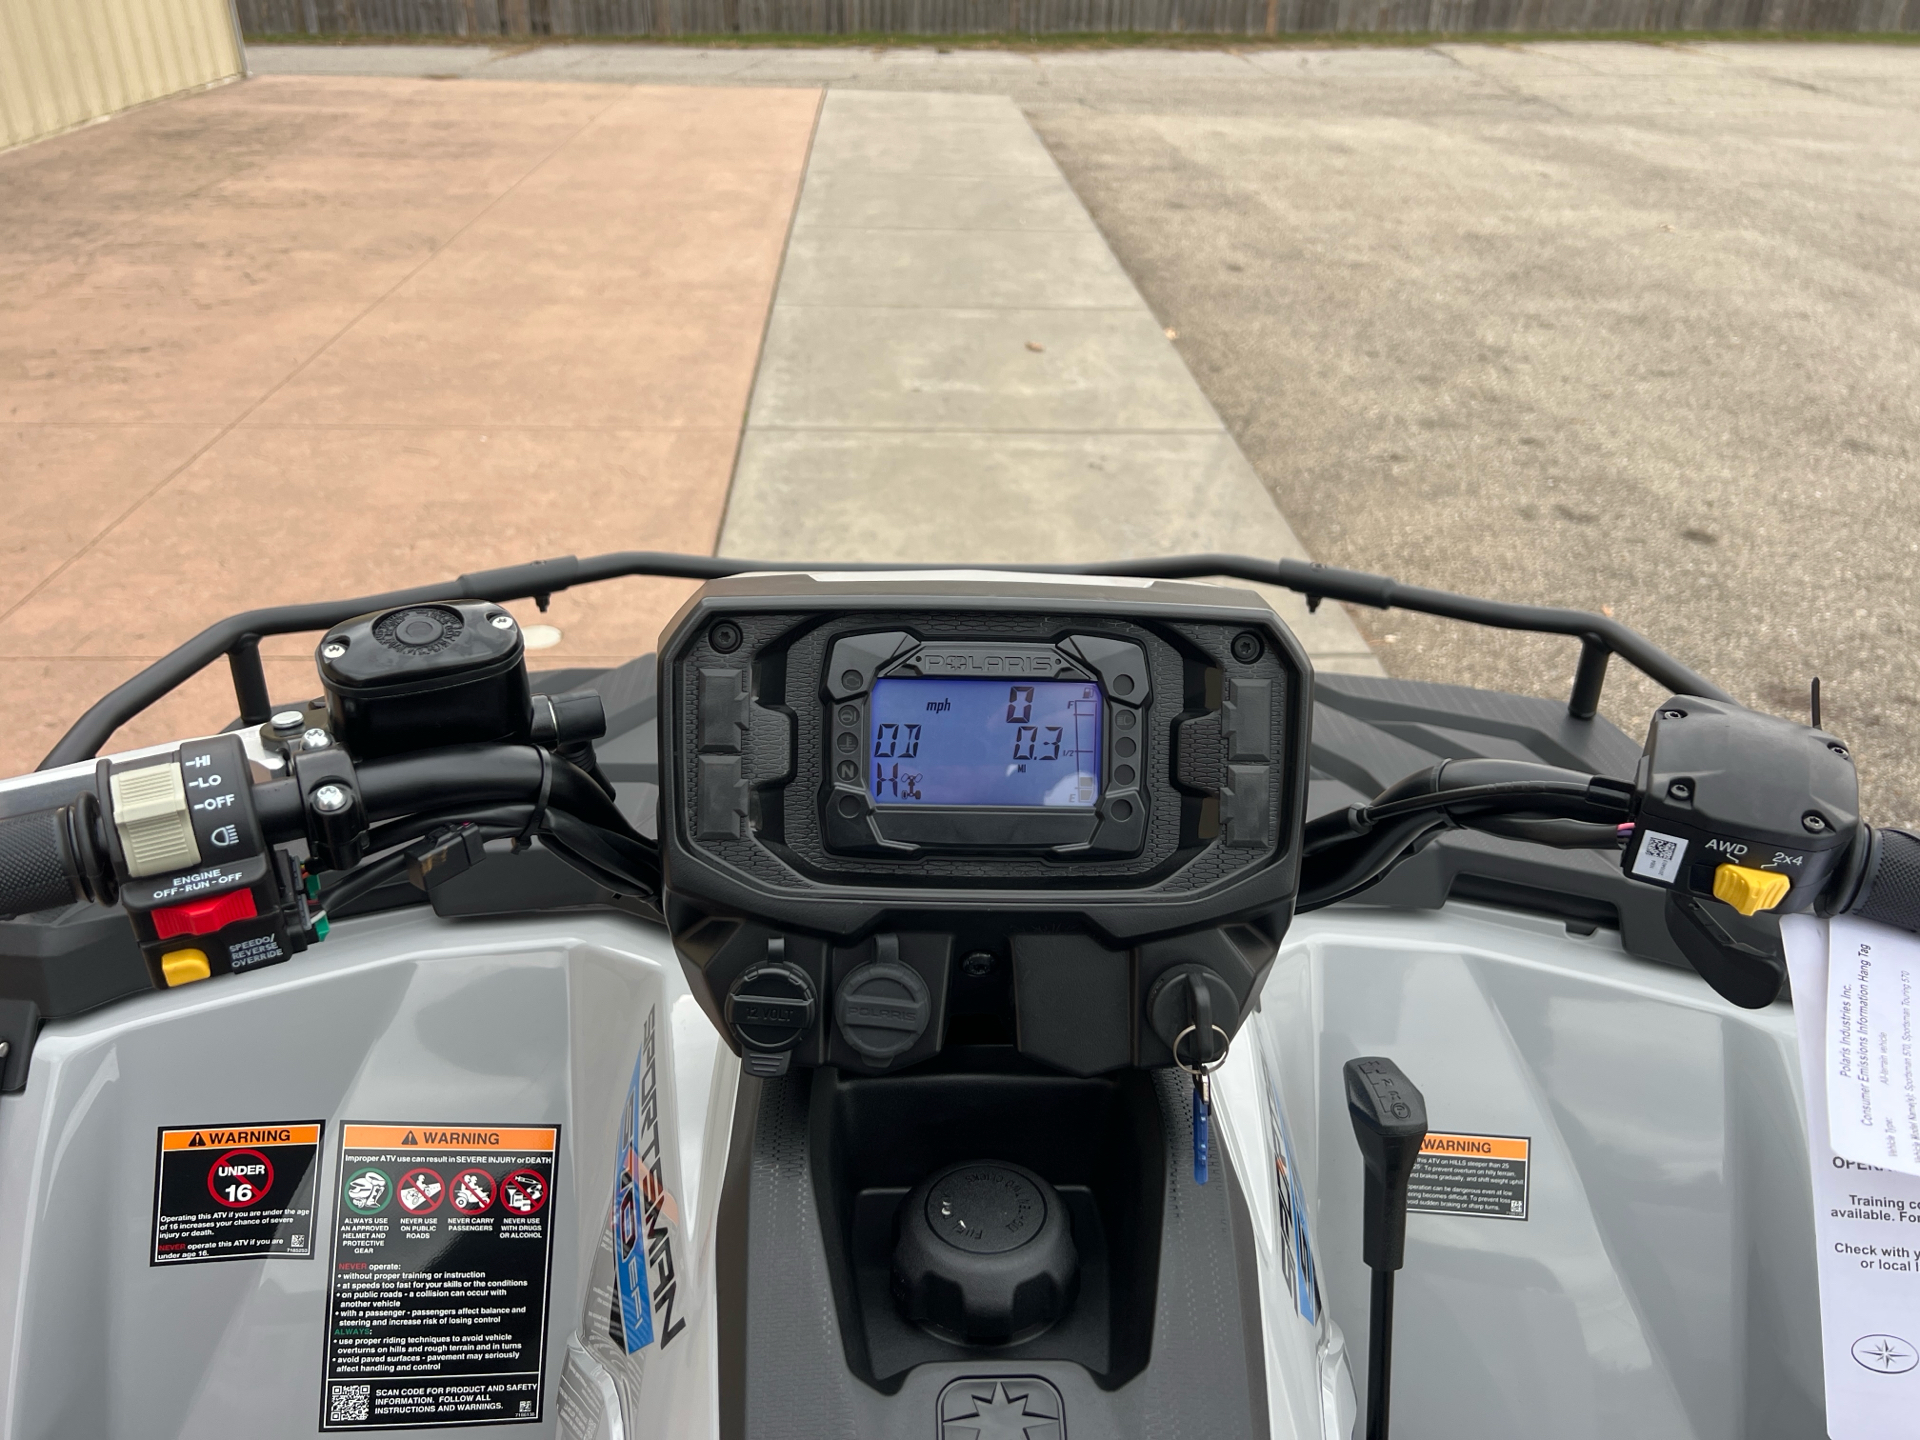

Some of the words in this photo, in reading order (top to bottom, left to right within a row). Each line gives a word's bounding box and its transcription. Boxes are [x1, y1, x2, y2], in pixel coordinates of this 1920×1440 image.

[926, 699, 951, 713] mph
[1013, 726, 1063, 760] 0.3
[1018, 764, 1026, 773] MI
[1705, 839, 1748, 855] AWD
[1772, 852, 1802, 866] 2x4
[173, 869, 221, 886] ENGINE
[229, 933, 275, 951] SPEEDO/
[232, 942, 279, 960] REVERSE
[1858, 944, 1871, 957] Tag
[232, 949, 283, 968] OVERRIDE
[1858, 960, 1871, 982] Hang
[1840, 984, 1852, 999] Inc.
[746, 1007, 758, 1020] 12
[762, 1008, 794, 1022] VOLT
[848, 1006, 917, 1021] POLARIS
[1857, 984, 1869, 1035] Information
[1840, 1002, 1851, 1045] Industries
[1840, 1048, 1851, 1078] Polaris
[1857, 1037, 1869, 1083] Emissions
[1859, 1084, 1873, 1126] Consumer
[210, 1130, 290, 1144] WARNING
[424, 1132, 500, 1145] WARNING
[1423, 1139, 1491, 1153] WARNING
[345, 1154, 379, 1162] Improper
[218, 1164, 265, 1176] UNDER
[225, 1184, 252, 1201] 16
[1849, 1194, 1904, 1210] Training
[160, 1214, 196, 1222] Operating
[262, 1209, 282, 1218] under
[1831, 1208, 1895, 1221] available.
[187, 1242, 216, 1250] operate
[1834, 1242, 1877, 1255] Check
[1881, 1247, 1909, 1257] with
[1860, 1260, 1874, 1268] or
[1879, 1259, 1910, 1271] local
[402, 1271, 432, 1280] training
[334, 1326, 372, 1335] ALWAYS:
[382, 1336, 406, 1344] riding
[445, 1385, 485, 1393] PRODUCT
[375, 1396, 434, 1405] INFORMATION.
[438, 1394, 473, 1402] FOLLOW
[374, 1405, 435, 1414] INSTRUCTIONS
[456, 1402, 503, 1410] WARNINGS.
